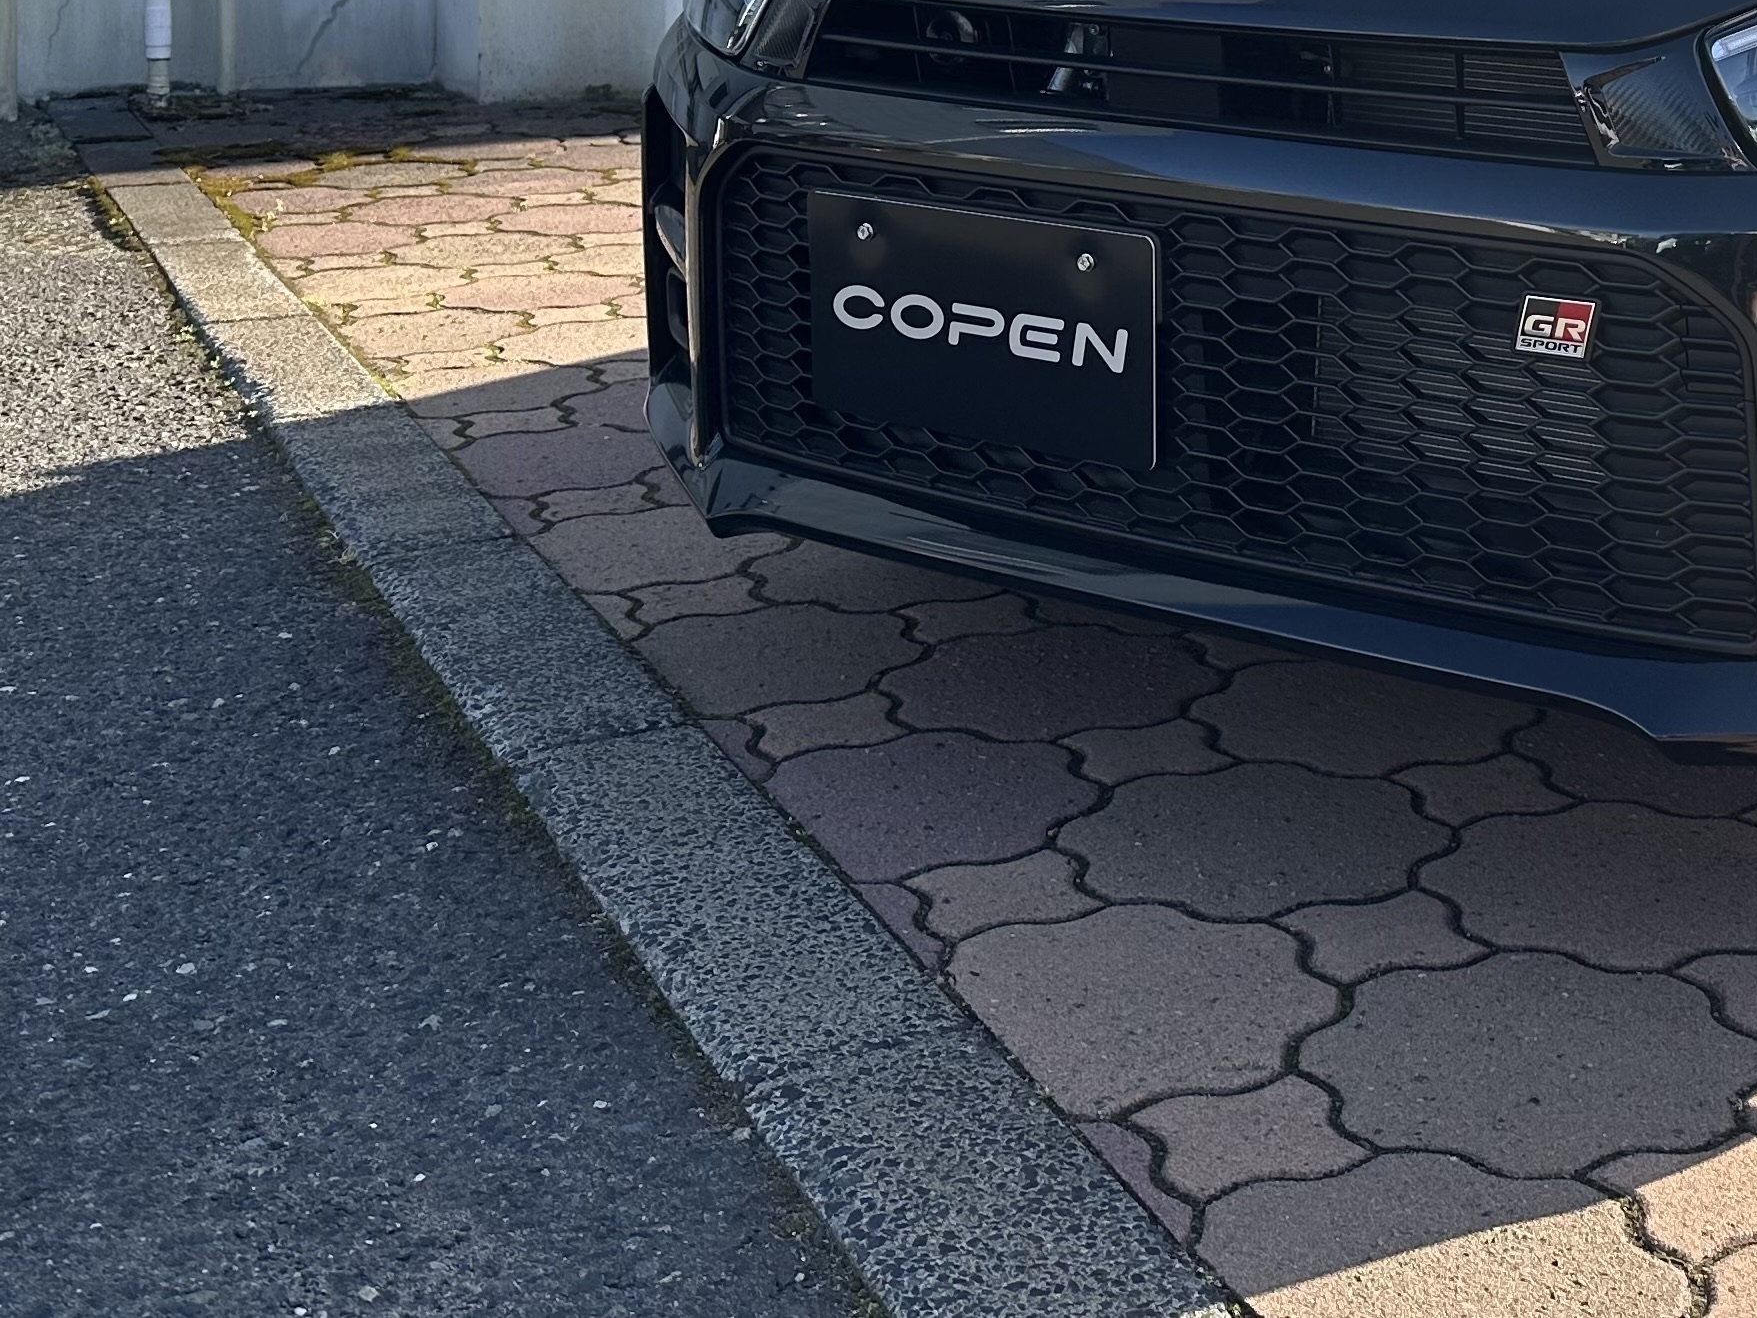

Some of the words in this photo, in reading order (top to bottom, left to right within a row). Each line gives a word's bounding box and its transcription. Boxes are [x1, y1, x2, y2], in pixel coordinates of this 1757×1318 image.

[832, 284, 1129, 374] COPEN
[1523, 313, 1587, 343] GR
[1519, 337, 1583, 354] SPORT
